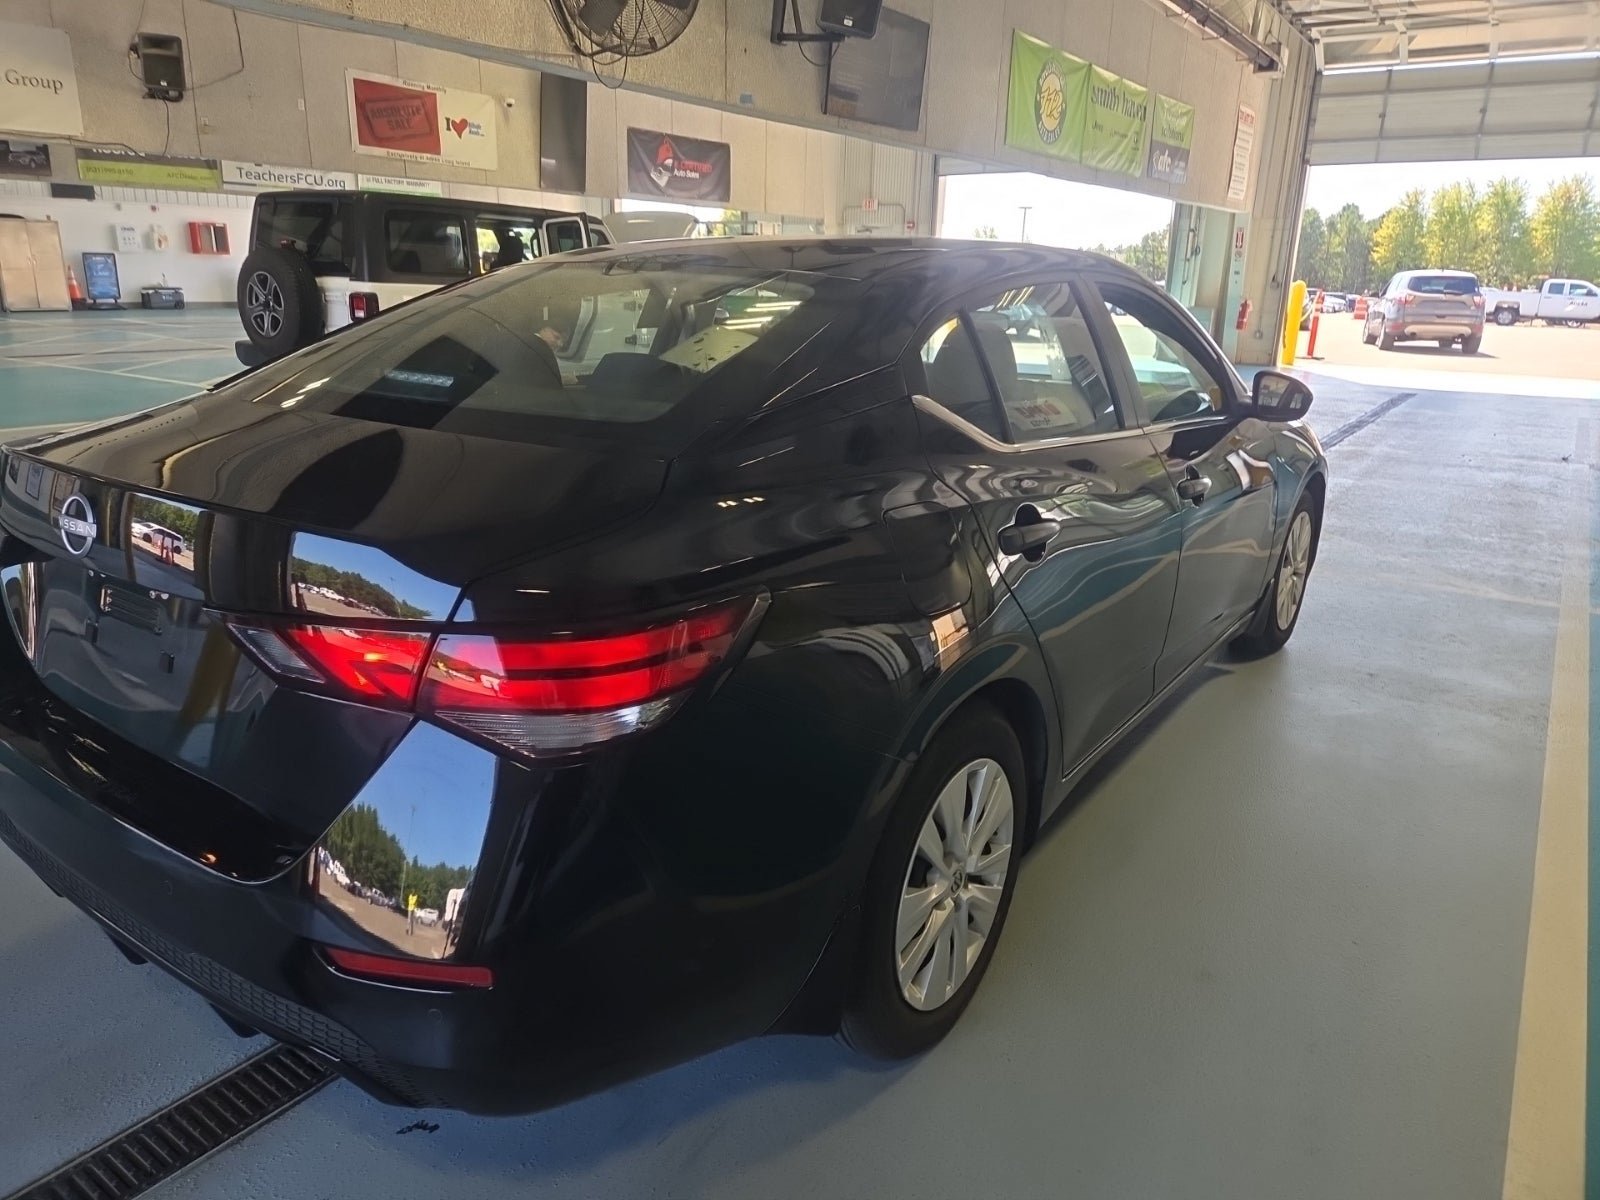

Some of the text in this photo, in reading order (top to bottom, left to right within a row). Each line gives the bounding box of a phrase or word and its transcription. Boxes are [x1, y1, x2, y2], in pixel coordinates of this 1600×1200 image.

[5, 69, 63, 94] Group
[370, 103, 423, 120] ABSOLUTE
[1091, 85, 1120, 112] smith
[1121, 90, 1147, 122] haven
[387, 117, 412, 131] SALE
[445, 117, 452, 132] I
[236, 166, 346, 191] TeachersFCU.org
[59, 516, 96, 537] ISSAN
